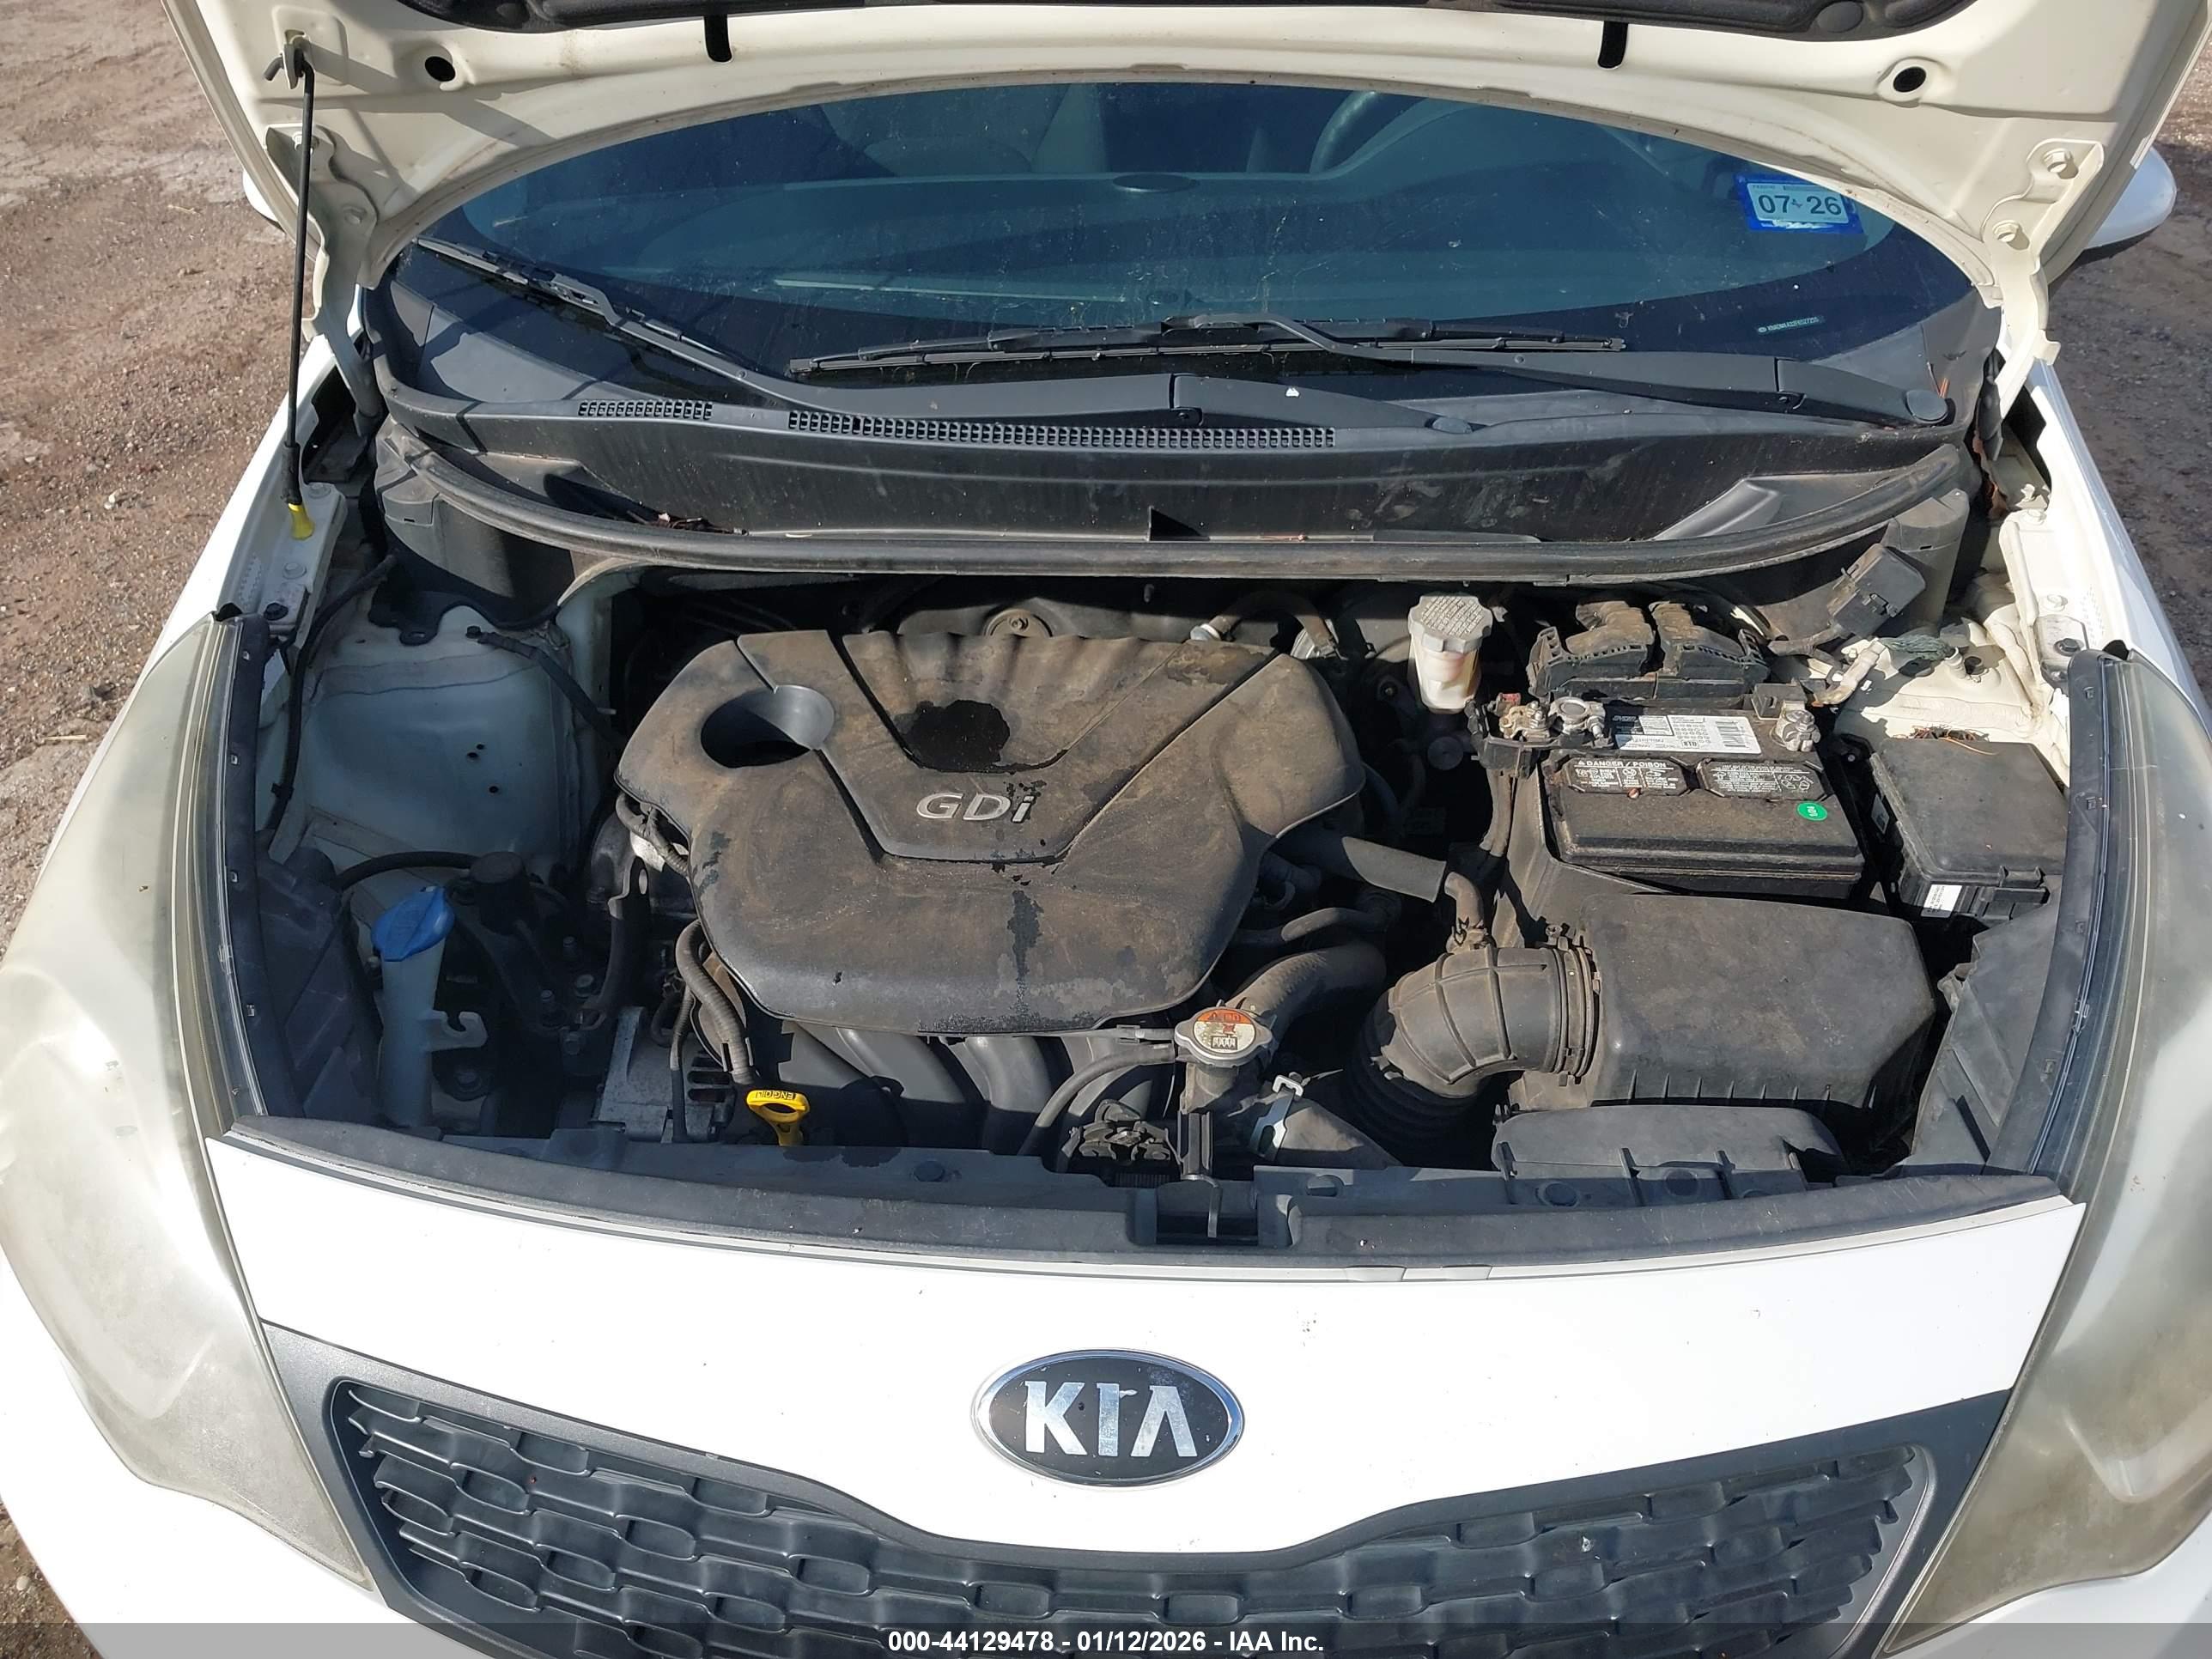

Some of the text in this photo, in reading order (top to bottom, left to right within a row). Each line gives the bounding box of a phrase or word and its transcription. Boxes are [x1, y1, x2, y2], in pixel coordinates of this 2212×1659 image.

[1758, 194, 1842, 216] 07 26
[915, 792, 1035, 823] GDi
[1024, 1381, 1198, 1457] KIA
